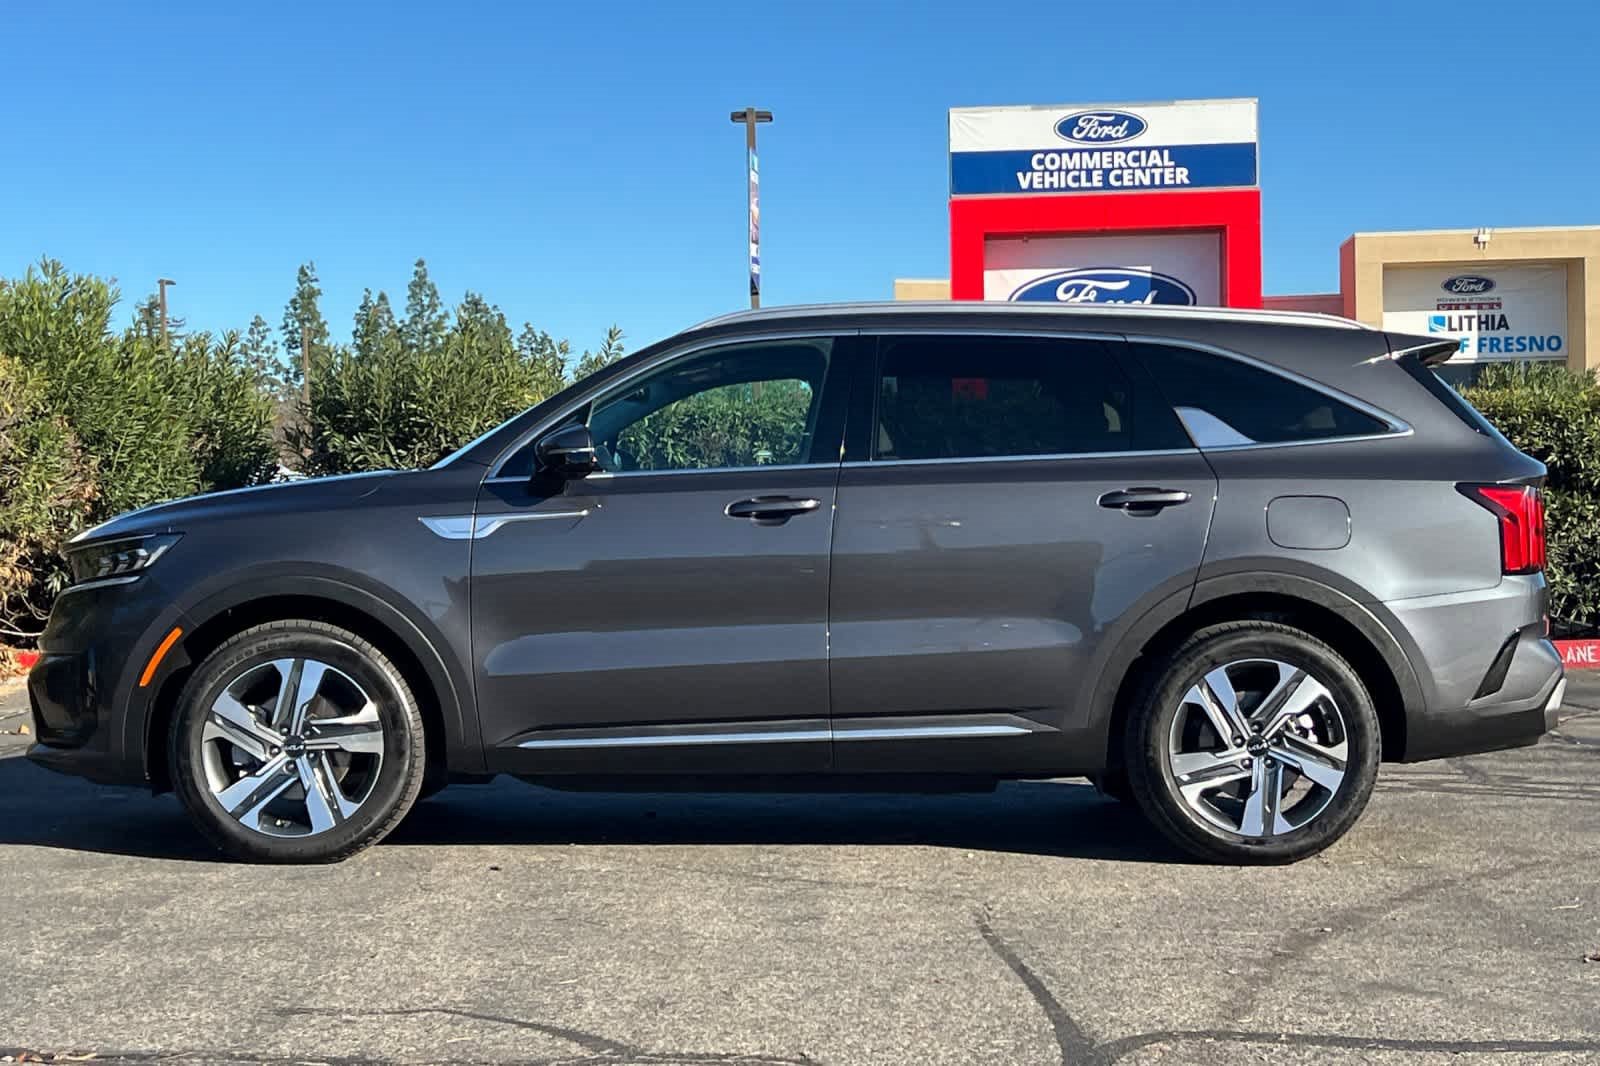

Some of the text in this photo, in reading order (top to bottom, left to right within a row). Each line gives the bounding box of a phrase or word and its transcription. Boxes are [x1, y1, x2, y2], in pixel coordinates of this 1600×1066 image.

[1072, 112, 1128, 139] Ford
[1031, 150, 1175, 171] COMMERCIAL
[1016, 167, 1190, 189] VEHICLE CENTER
[1452, 278, 1486, 292] Ford
[1447, 314, 1510, 332] LITHIA
[1478, 335, 1562, 353] FRESNO
[1562, 645, 1598, 663] ANE
